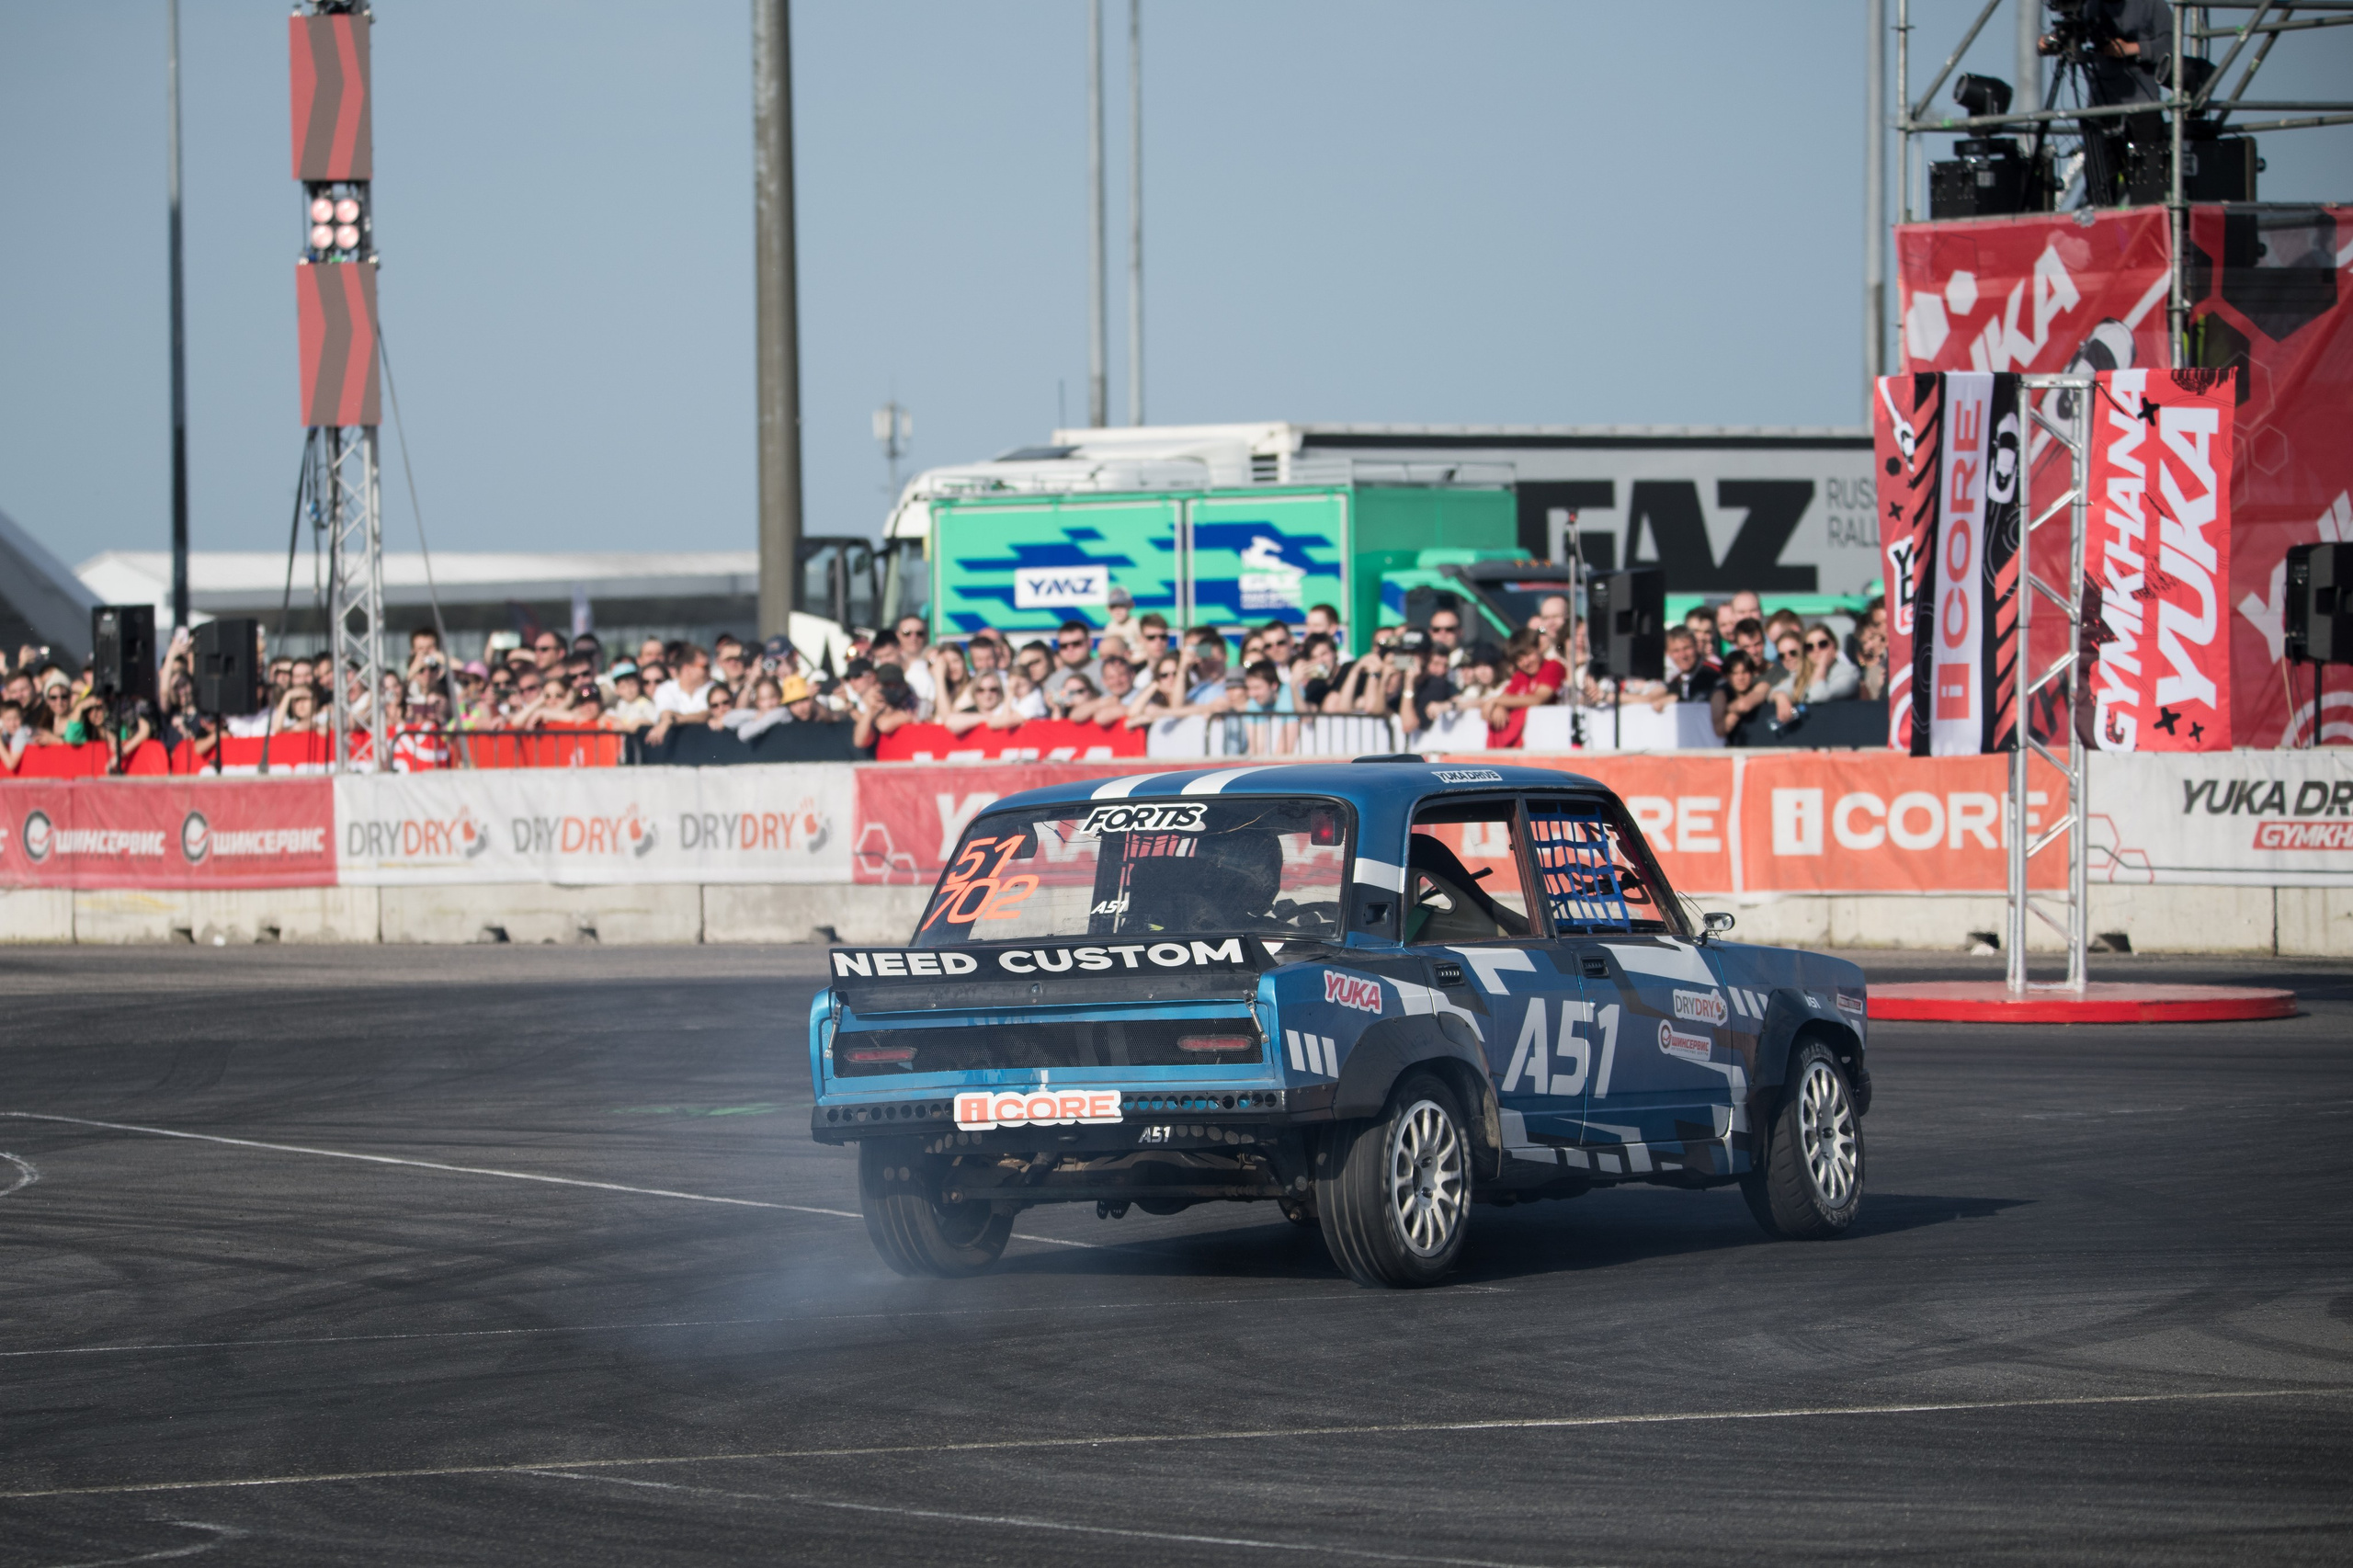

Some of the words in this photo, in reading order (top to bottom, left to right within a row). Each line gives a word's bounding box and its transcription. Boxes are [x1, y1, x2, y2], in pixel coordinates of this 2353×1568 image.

[1827, 477, 1878, 509] RUS
[2094, 369, 2149, 752] GYMKHANA
[2155, 407, 2219, 710] YUKA
[1436, 771, 1469, 781] YUKA
[1468, 770, 1499, 779] DRIVE
[2182, 779, 2286, 816] YUKA
[511, 817, 620, 854] DRYDRY
[679, 812, 797, 850] DRYDRY
[1081, 805, 1207, 832] FORTIS
[54, 829, 166, 856] ШИНСЕРВИС
[212, 827, 325, 855] ШИНСЕРВИС
[347, 821, 456, 857] DRYDRY
[947, 835, 1027, 885] 51
[921, 874, 1040, 932] 702
[1090, 900, 1129, 915] A51
[833, 951, 978, 977] NEED
[998, 937, 1245, 973] CUSTOM
[1325, 971, 1381, 1012] YUKA
[1675, 995, 1714, 1017] DRYDRY
[1501, 997, 1620, 1099] A51
[1671, 1036, 1710, 1052] ШИНСЕРВИС
[1138, 1126, 1171, 1143] A51
